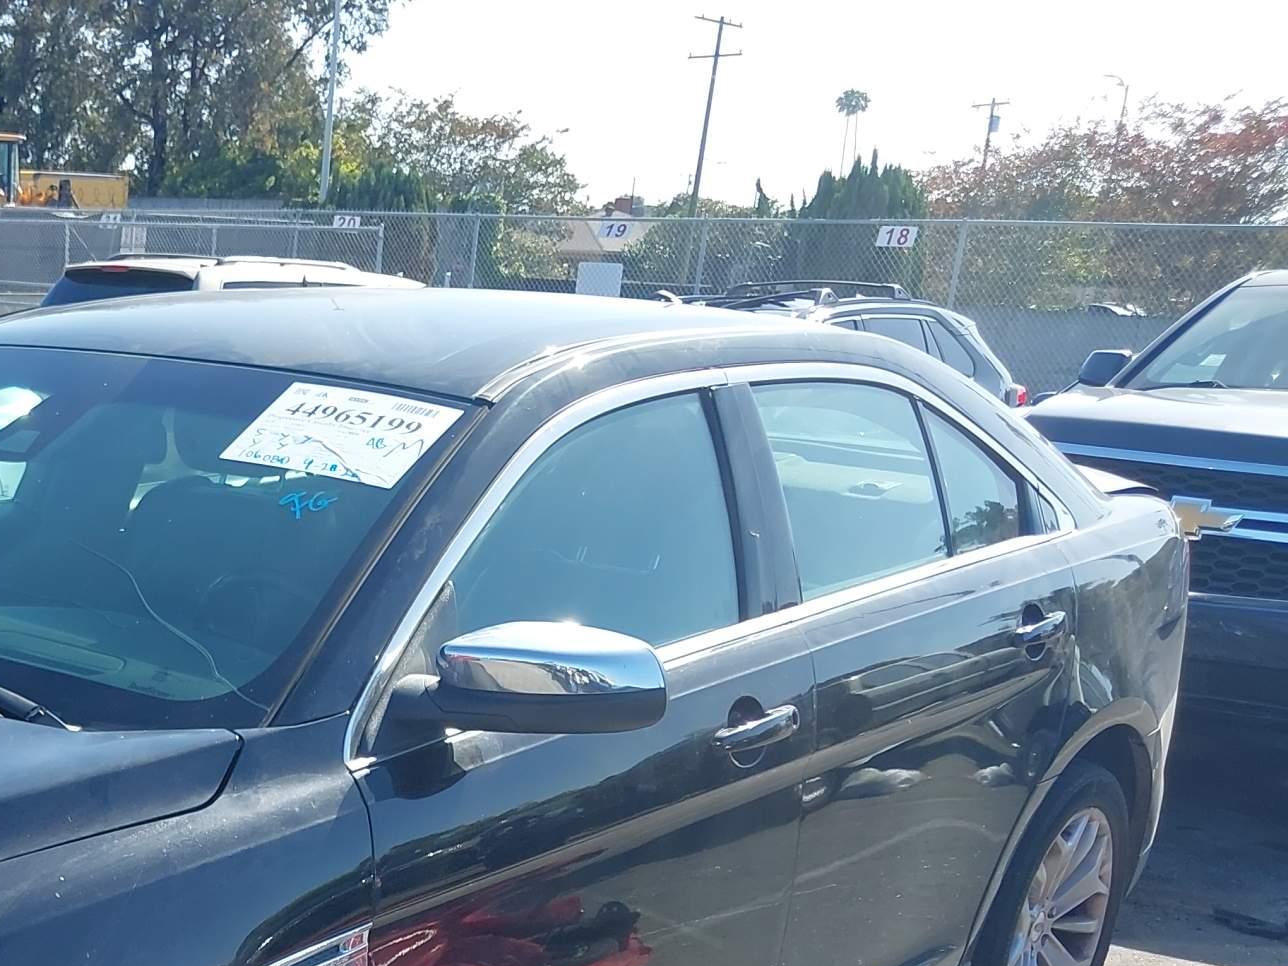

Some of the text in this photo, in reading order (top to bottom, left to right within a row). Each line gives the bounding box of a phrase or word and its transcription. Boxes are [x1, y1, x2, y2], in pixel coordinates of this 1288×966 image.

[606, 224, 627, 237] 19
[886, 228, 910, 245] 18
[285, 402, 422, 434] 44965199
